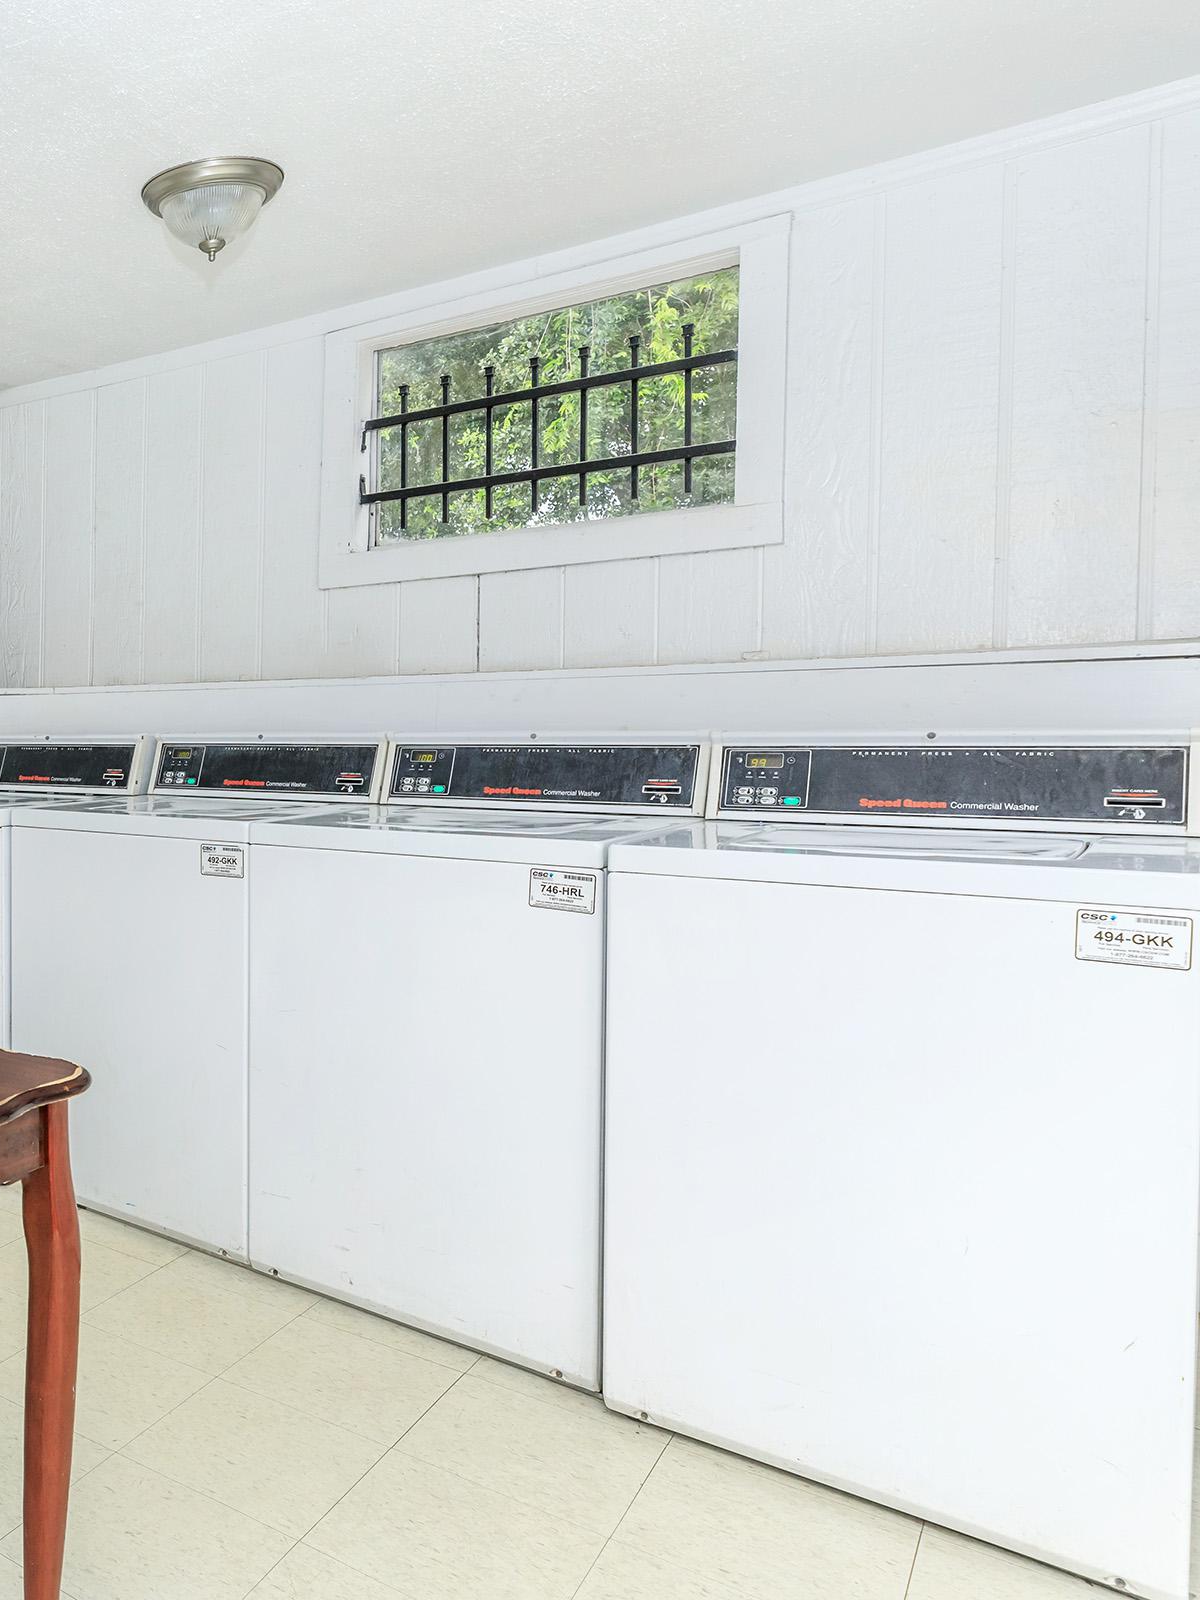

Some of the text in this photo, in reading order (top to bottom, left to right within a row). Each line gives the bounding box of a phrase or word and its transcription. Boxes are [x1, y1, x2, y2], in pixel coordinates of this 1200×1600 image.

[483, 786, 512, 795] Speed
[512, 787, 541, 795] Queen
[859, 798, 1039, 812] Speed Queen Commercial Washer
[208, 857, 237, 865] 492-GKK
[540, 884, 584, 897] 746-HRL
[1081, 913, 1108, 921] CSC
[1094, 931, 1173, 948] 494-GKK
